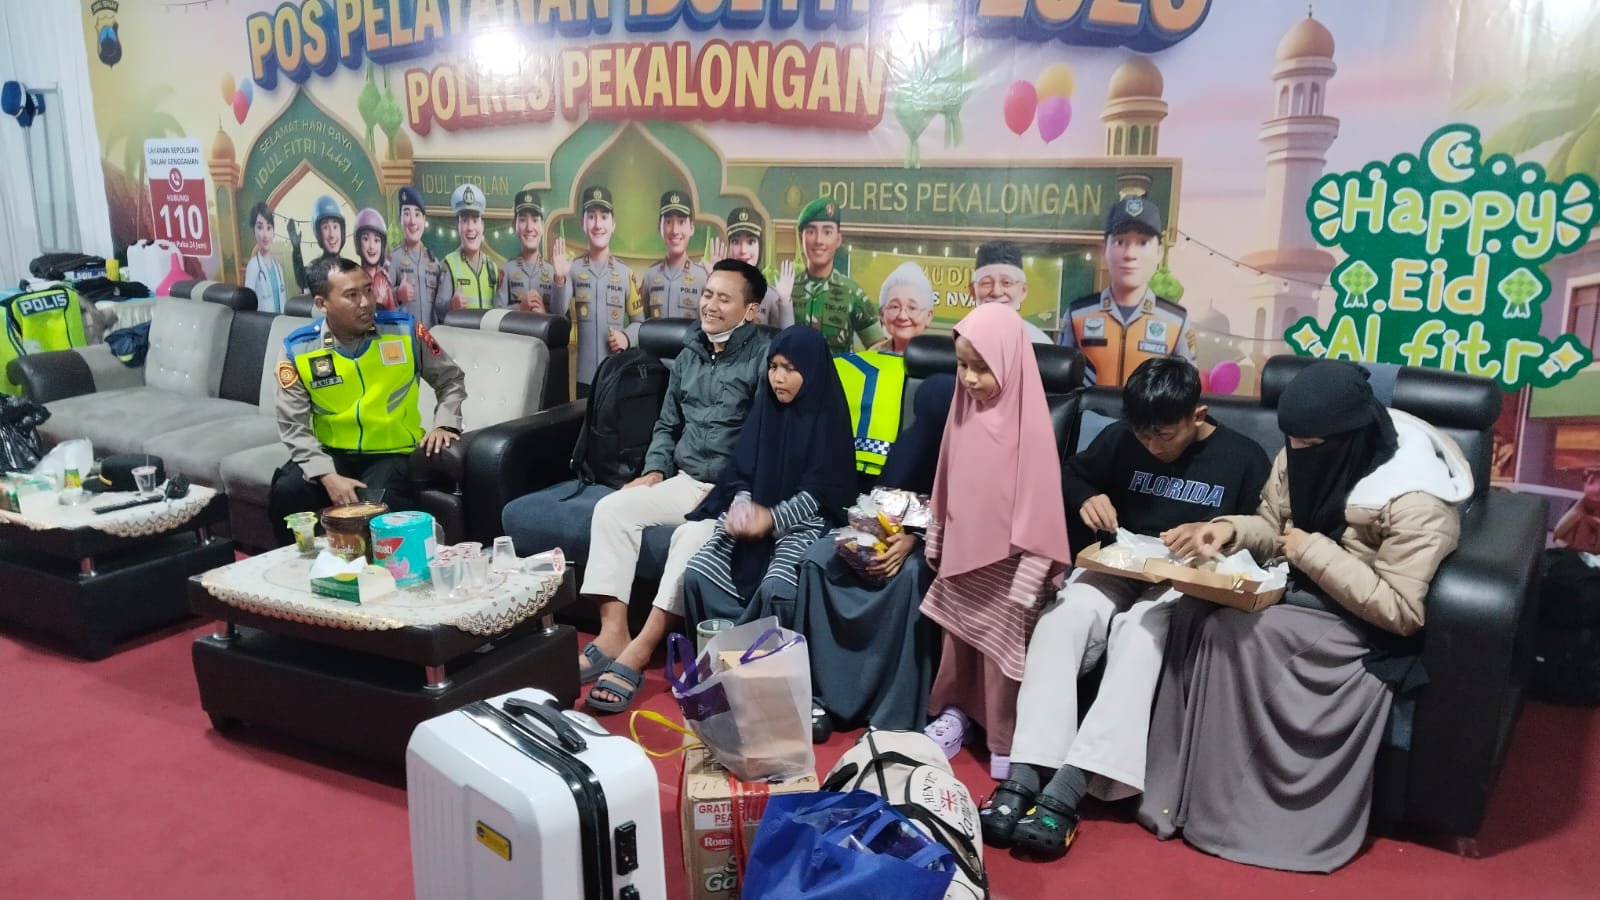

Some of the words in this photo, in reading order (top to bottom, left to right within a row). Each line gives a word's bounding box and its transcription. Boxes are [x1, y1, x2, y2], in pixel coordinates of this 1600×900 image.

[249, 1, 328, 80] POS
[564, 43, 885, 116] PEKALONGAN
[260, 121, 298, 154] SELAMAT
[302, 119, 326, 133] HARI
[255, 153, 282, 189] IDUL
[283, 138, 316, 159] FITRI
[351, 172, 365, 192] H
[160, 204, 203, 240] 110
[818, 181, 908, 212] POLRES
[916, 182, 1102, 216] PEKALONGAN
[1342, 178, 1557, 259] Happy
[20, 294, 68, 315] POLIS
[1389, 253, 1490, 316] Eid
[1326, 313, 1381, 364] Al
[1400, 319, 1544, 385] fitr
[1128, 470, 1225, 508] FLORIDA
